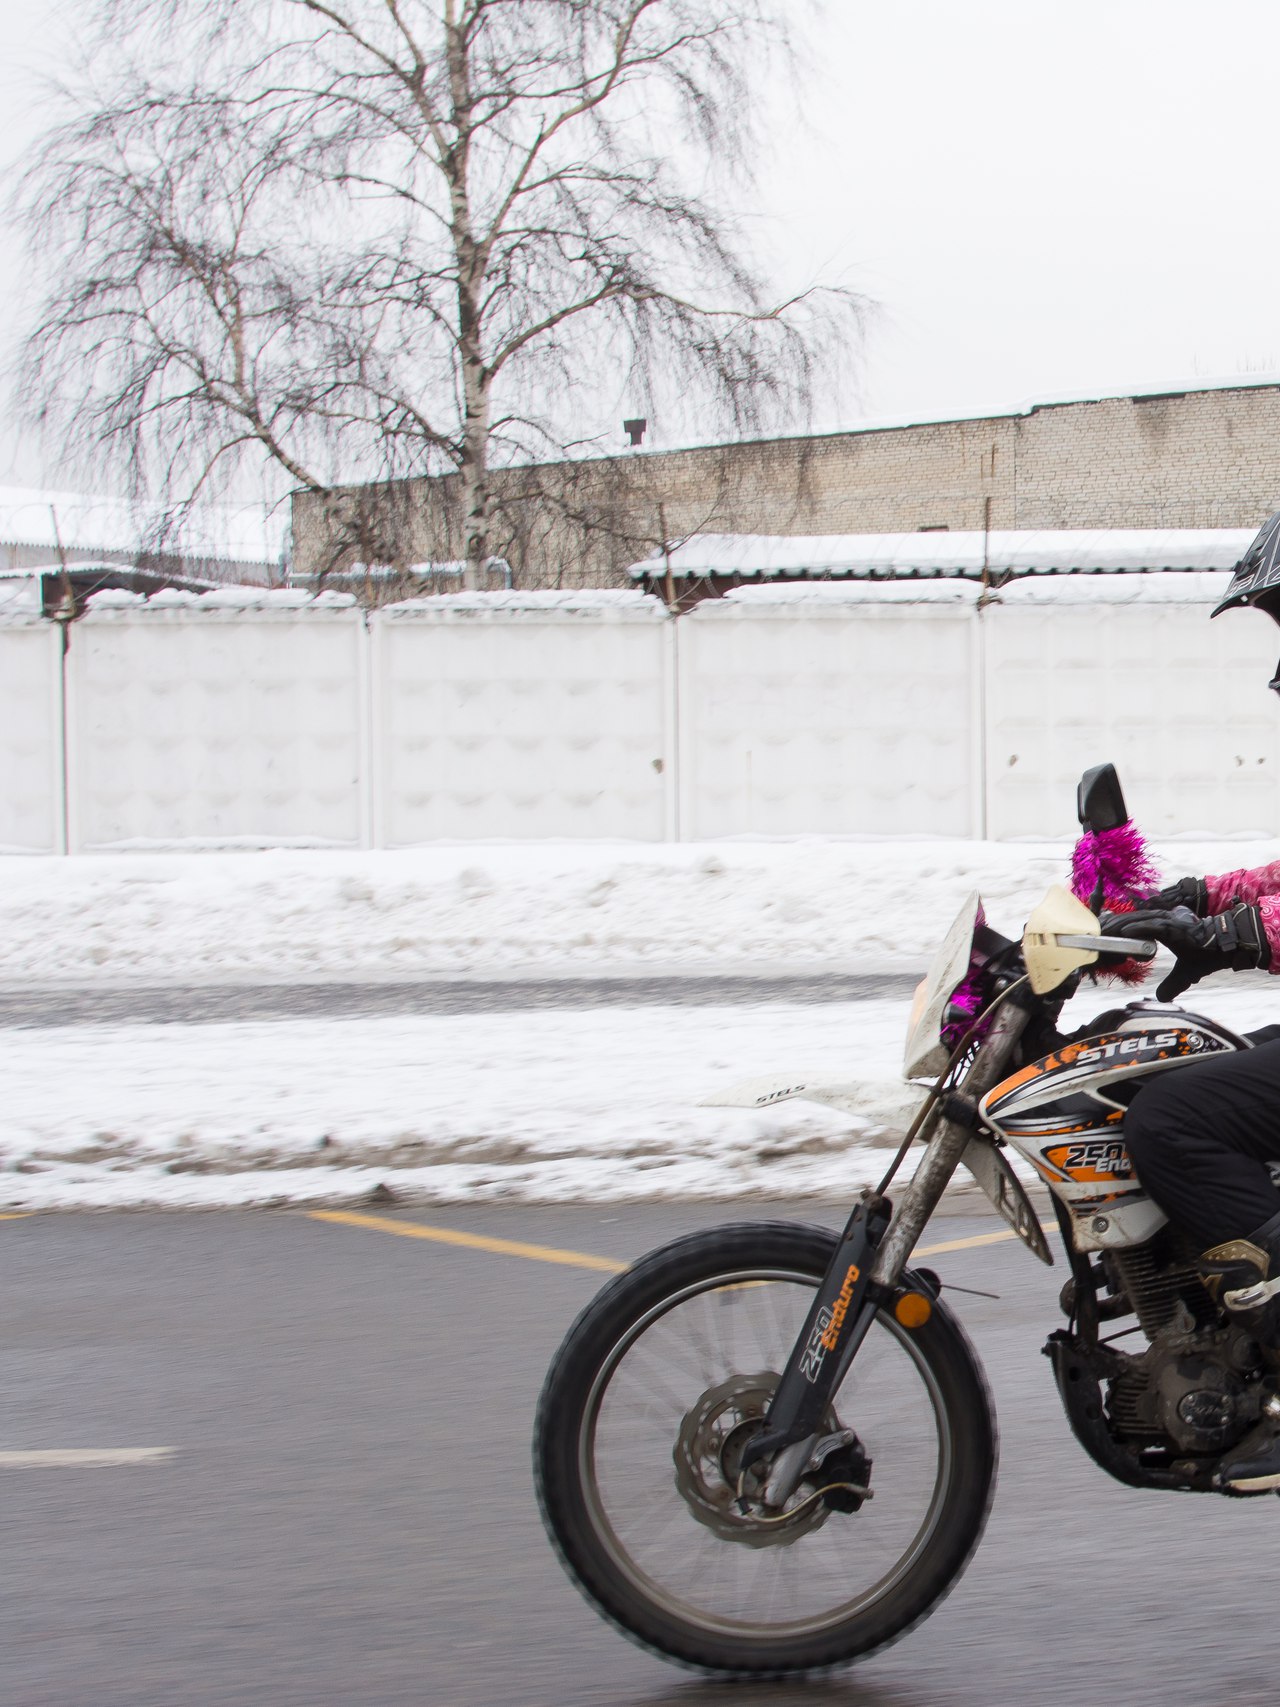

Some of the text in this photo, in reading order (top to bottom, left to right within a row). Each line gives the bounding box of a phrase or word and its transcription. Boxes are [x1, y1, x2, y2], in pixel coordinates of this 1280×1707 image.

[1076, 1032, 1178, 1067] STELS
[755, 1082, 807, 1105] STELS
[1063, 1142, 1132, 1173] 250 End
[799, 1264, 860, 1384] 250 Enduro
